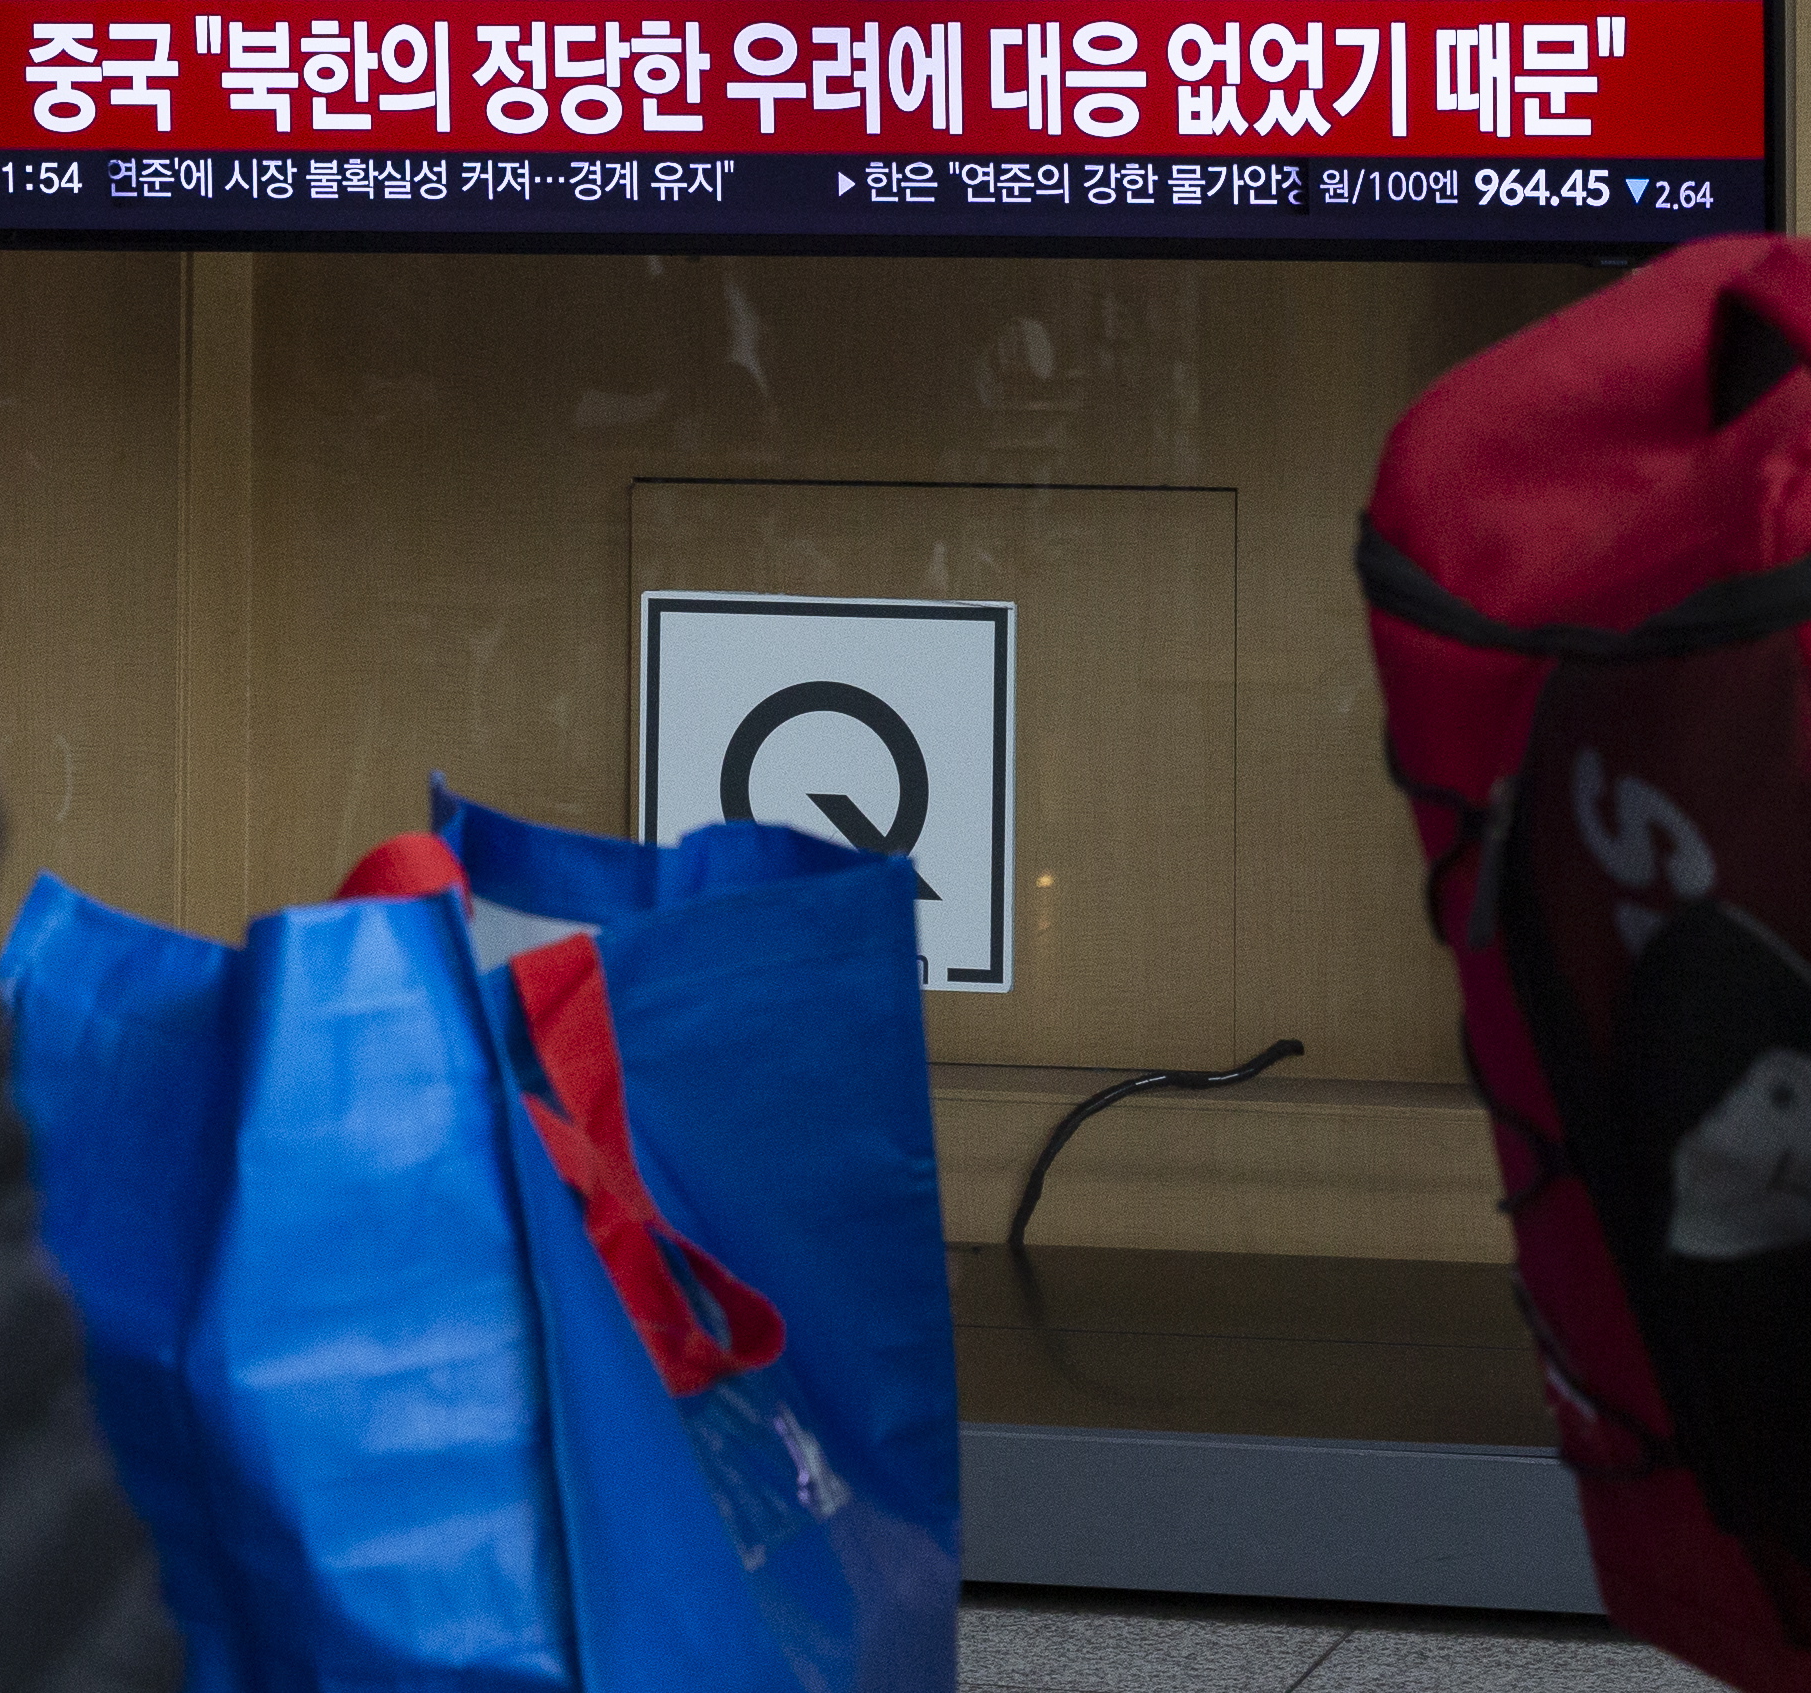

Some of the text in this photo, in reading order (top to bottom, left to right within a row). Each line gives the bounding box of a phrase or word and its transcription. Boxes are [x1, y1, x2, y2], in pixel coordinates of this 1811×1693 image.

[25, 16, 1627, 139] 중국 "북한의 정당한 우려에 대응 없었기 때문"
[224, 158, 298, 200] 시장
[305, 158, 449, 202] 불확실성
[650, 159, 737, 203] 유지"
[865, 161, 940, 204] 한은
[948, 161, 1071, 205] "연준의
[1083, 163, 1160, 206] 강한
[1319, 168, 1716, 211] 원/100엔 964.45 2.64
